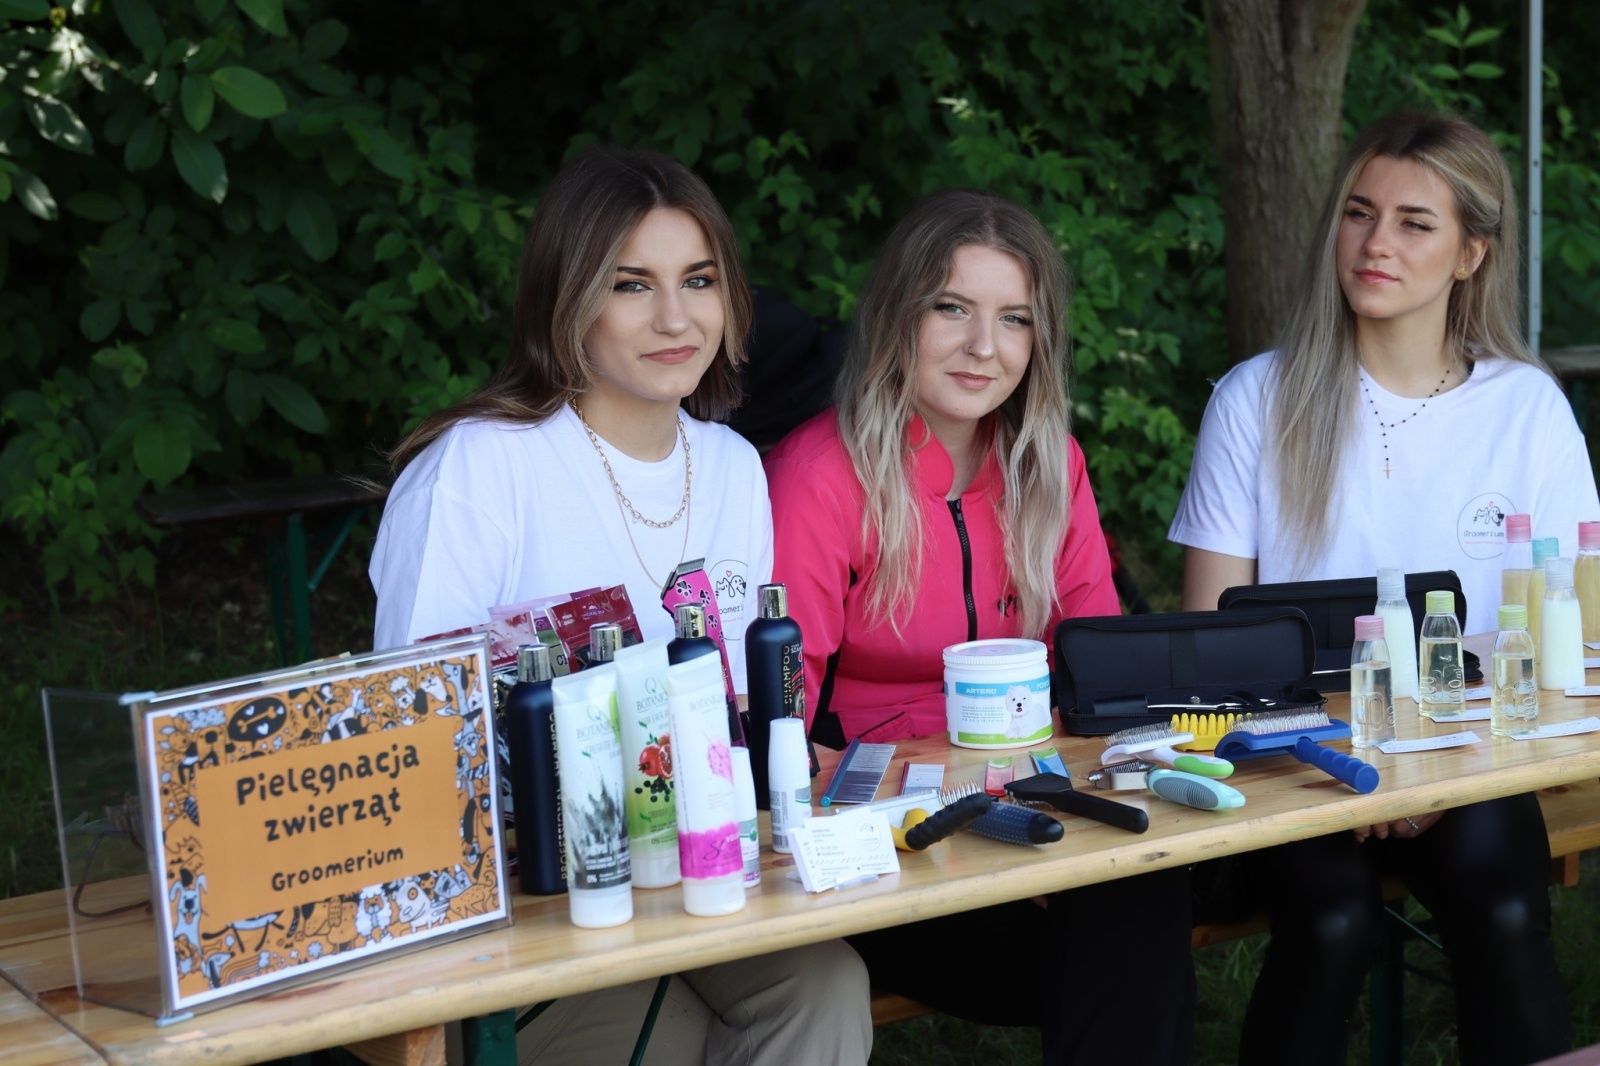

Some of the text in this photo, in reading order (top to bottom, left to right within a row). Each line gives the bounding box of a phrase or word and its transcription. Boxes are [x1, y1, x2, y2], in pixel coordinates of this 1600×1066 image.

[783, 645, 792, 704] SHAMPOO
[237, 744, 420, 806] Pielęgnacja
[264, 787, 401, 842] zwierząt
[271, 847, 404, 891] Groomerium
